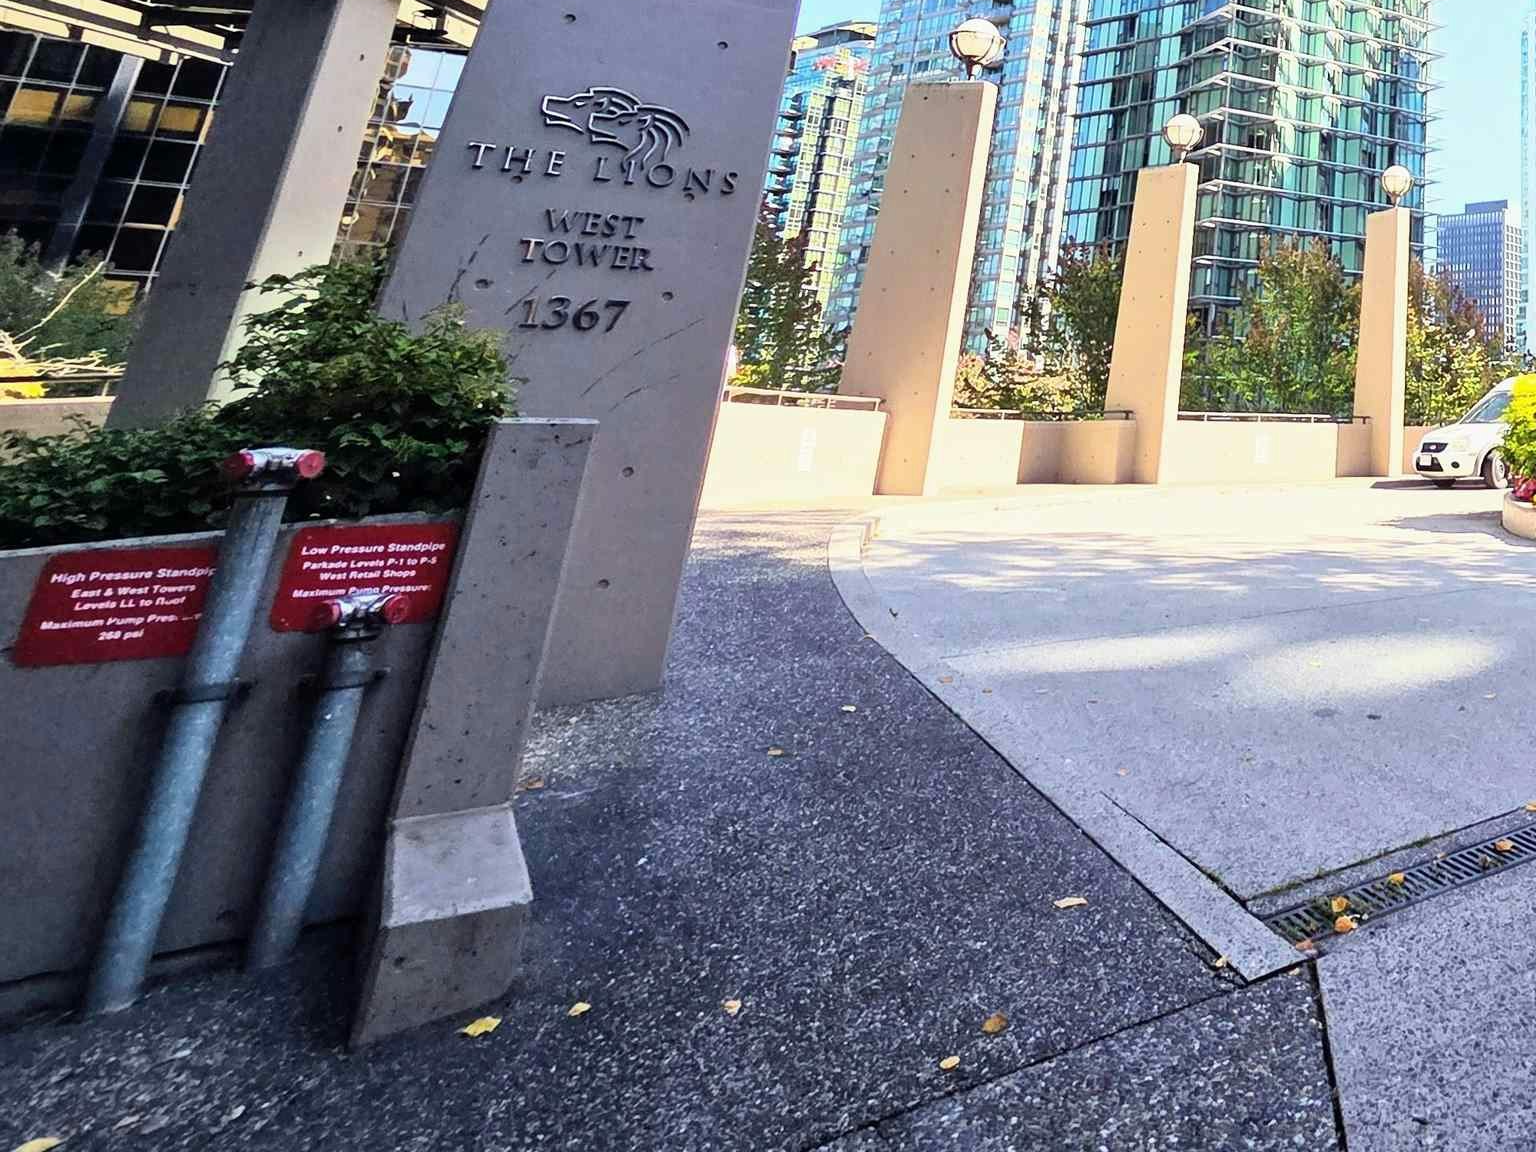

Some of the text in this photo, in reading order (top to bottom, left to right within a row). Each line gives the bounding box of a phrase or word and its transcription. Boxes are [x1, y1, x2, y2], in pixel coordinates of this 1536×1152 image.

[468, 141, 740, 196] THE LIONS
[544, 208, 645, 239] WEST
[519, 237, 654, 271] TOWER
[517, 296, 632, 334] 1367
[301, 542, 446, 556] Low Pressure Standpipe
[302, 560, 348, 570] Parkade
[350, 559, 384, 568] Levels
[50, 572, 87, 585] High
[89, 569, 153, 583] Pressure
[319, 569, 417, 581] West Retail Shops
[70, 583, 196, 599] East & West Towers
[292, 588, 346, 598] Maximum
[74, 599, 117, 611] Levels
[119, 598, 137, 608] LL
[139, 597, 153, 607] to
[40, 617, 104, 630] Maximum
